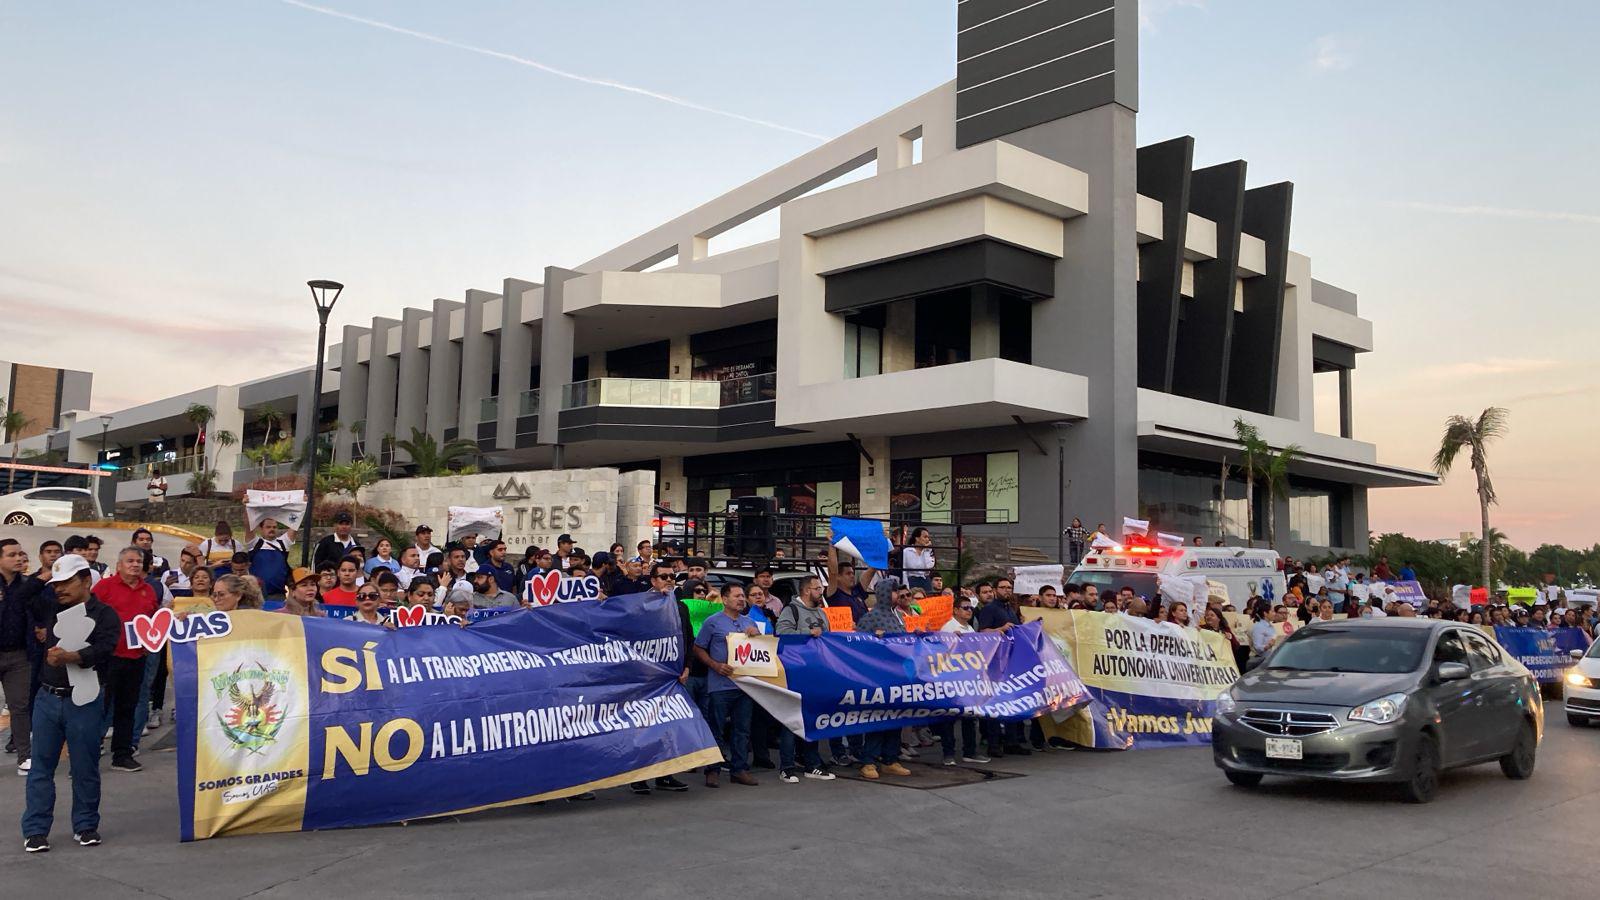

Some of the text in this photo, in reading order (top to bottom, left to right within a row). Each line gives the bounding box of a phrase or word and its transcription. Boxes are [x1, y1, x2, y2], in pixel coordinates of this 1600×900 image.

[513, 505, 583, 530] TRES
[507, 536, 550, 545] center
[558, 578, 598, 600] UAS
[170, 612, 230, 640] UAS
[750, 650, 771, 662] UAS
[1105, 628, 1132, 651] POR
[1134, 631, 1149, 652] LA
[1150, 633, 1193, 659] DEFENSA
[1203, 643, 1218, 662] LA
[321, 641, 384, 693] SÍ
[387, 658, 400, 683] A
[401, 657, 423, 683] LA
[422, 650, 546, 680] TRANSPARENCIA
[634, 636, 679, 662] CUENTAS
[928, 650, 989, 678] ¡ALTO!
[1093, 653, 1168, 680] AUTONOMÍA
[1522, 655, 1558, 666] PERSECUC
[839, 689, 856, 705] A
[860, 687, 885, 705] LA
[889, 675, 995, 703] PERSECUCIÓN
[992, 661, 1055, 697] POLÍTICA
[815, 707, 960, 730] GOBERNADOR
[963, 705, 986, 717] EN
[985, 691, 1047, 719] CONTRA
[1106, 706, 1179, 736] ¡Vamos
[431, 693, 694, 759] A LA INTROMISIÓN DEL GOBIERNO
[321, 717, 425, 780] NO
[198, 769, 303, 791] SOMOS GRANDES
[223, 781, 277, 802] Somos UAS
